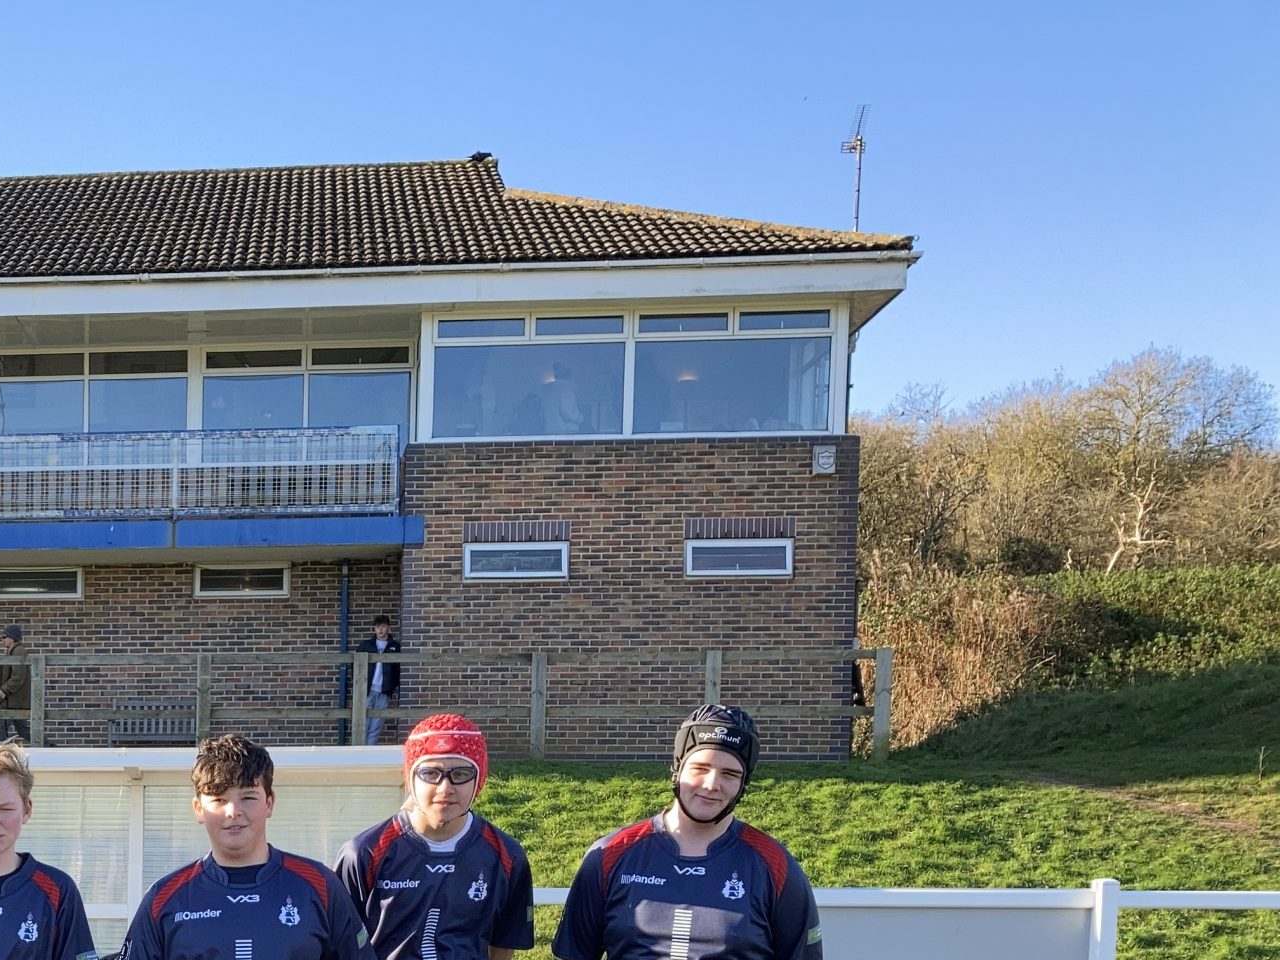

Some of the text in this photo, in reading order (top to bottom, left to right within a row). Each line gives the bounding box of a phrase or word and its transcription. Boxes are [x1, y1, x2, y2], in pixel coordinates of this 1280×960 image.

[699, 731, 740, 743] optimum
[425, 863, 456, 873] VX3
[673, 864, 707, 876] VX3
[383, 879, 420, 889] Oander
[226, 894, 260, 904] VX3
[182, 909, 222, 921] Oander
